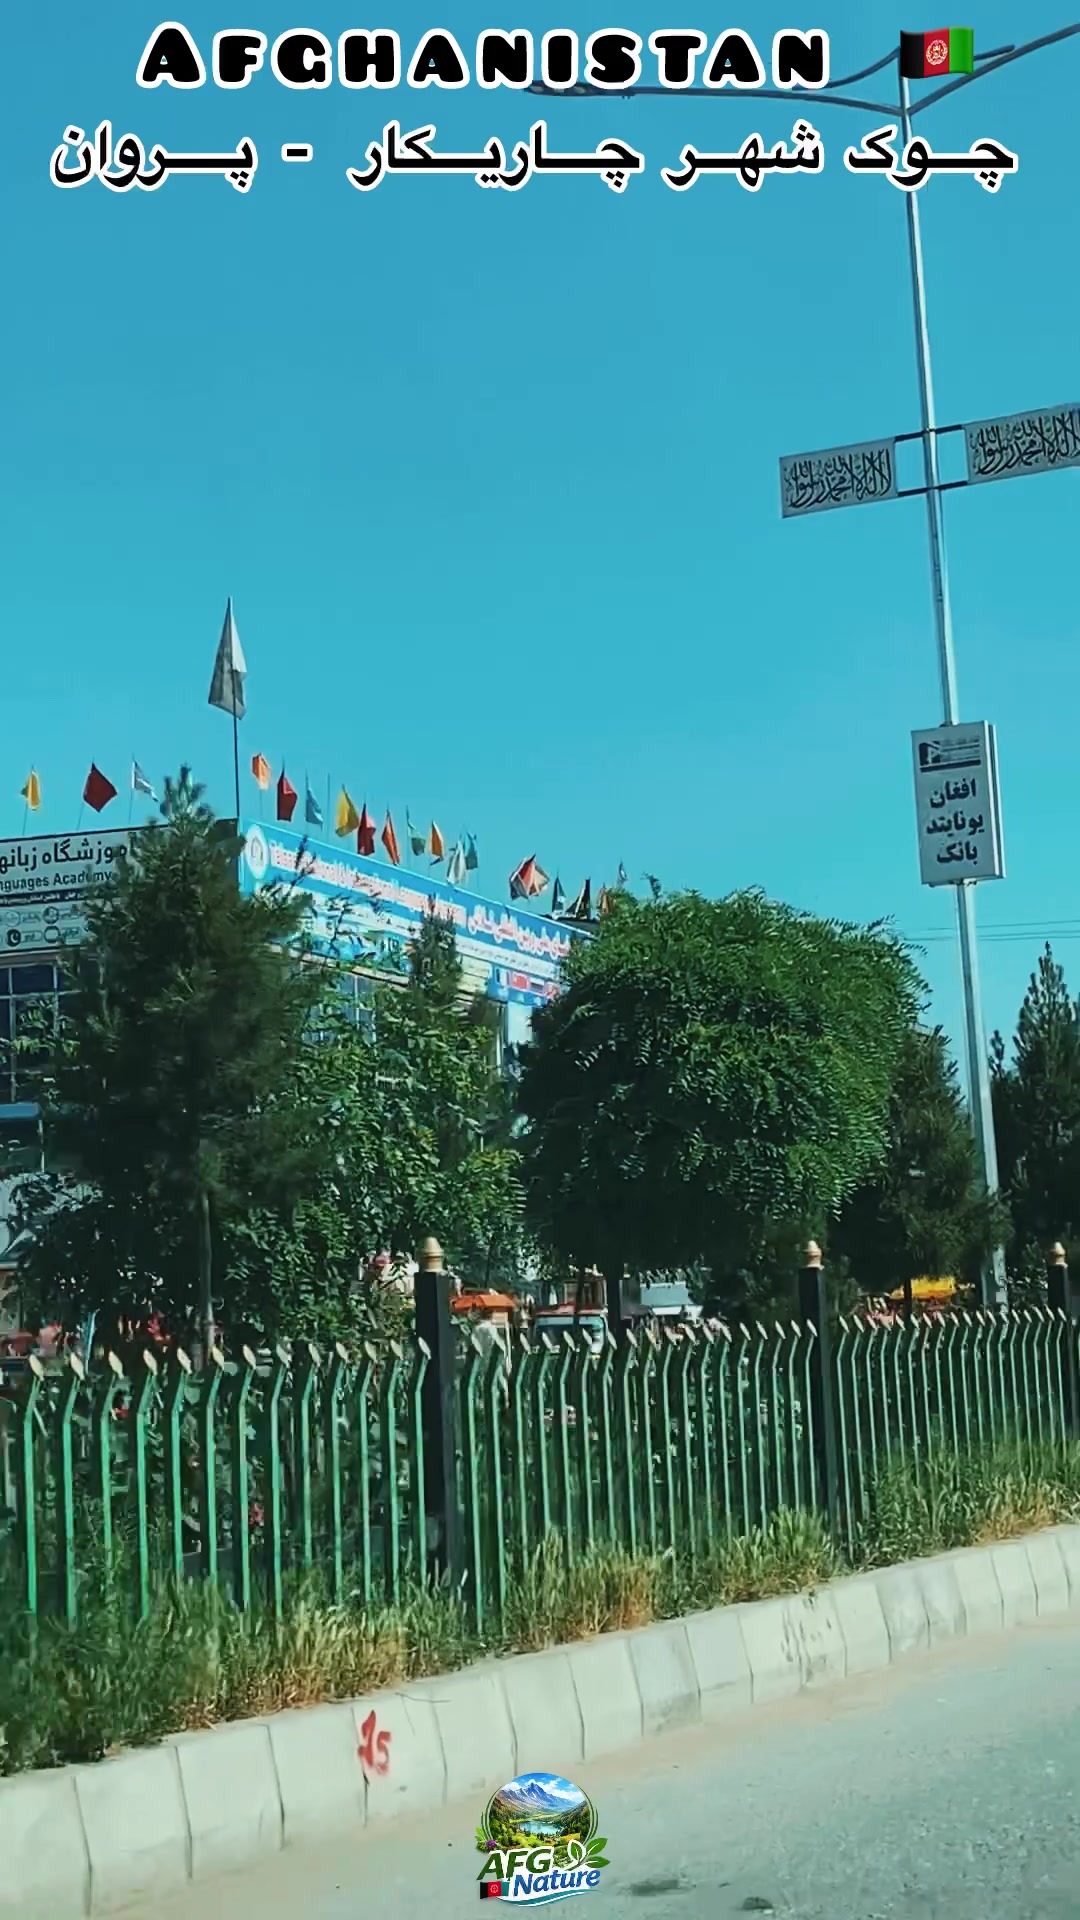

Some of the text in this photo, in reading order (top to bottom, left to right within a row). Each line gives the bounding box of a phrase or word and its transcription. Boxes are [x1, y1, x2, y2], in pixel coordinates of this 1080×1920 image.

[929, 777, 976, 808] افغان
[0, 837, 127, 874] موزشگاه زبانه
[936, 840, 978, 865] بانک
